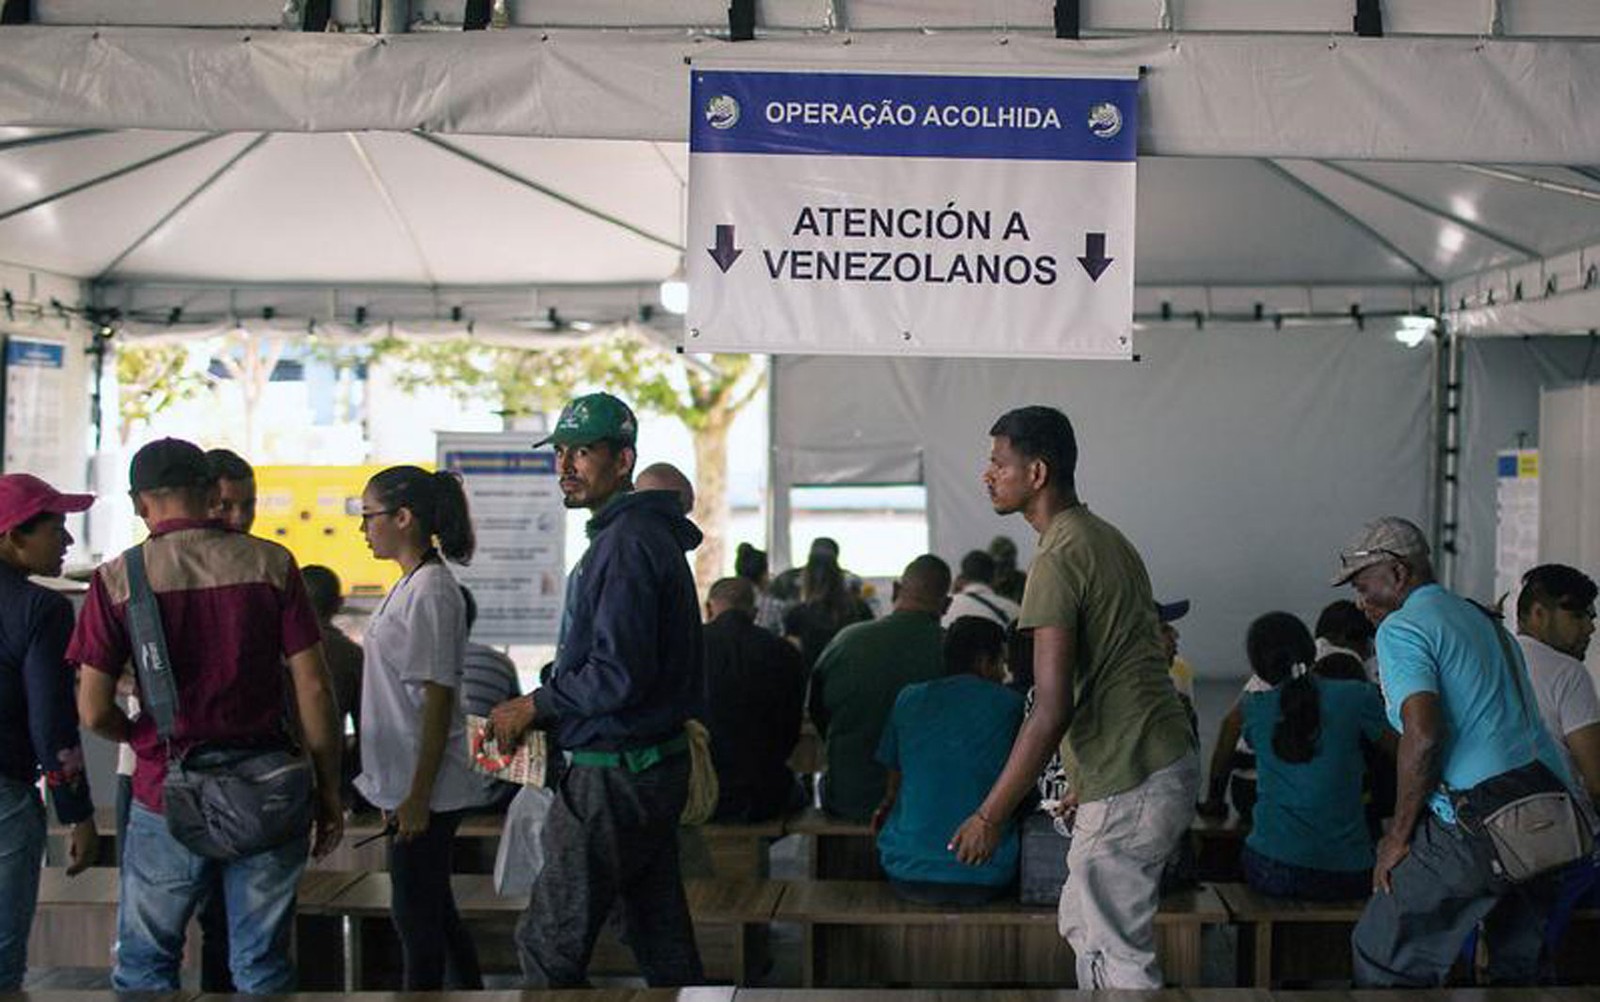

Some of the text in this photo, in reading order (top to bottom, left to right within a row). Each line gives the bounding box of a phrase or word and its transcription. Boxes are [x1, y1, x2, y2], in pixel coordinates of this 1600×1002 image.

[765, 100, 1062, 130] OPERAÇÃO ACOLHIDA
[793, 201, 1030, 241] ATENCIÓN A
[763, 249, 1057, 285] VENEZOLANOS
